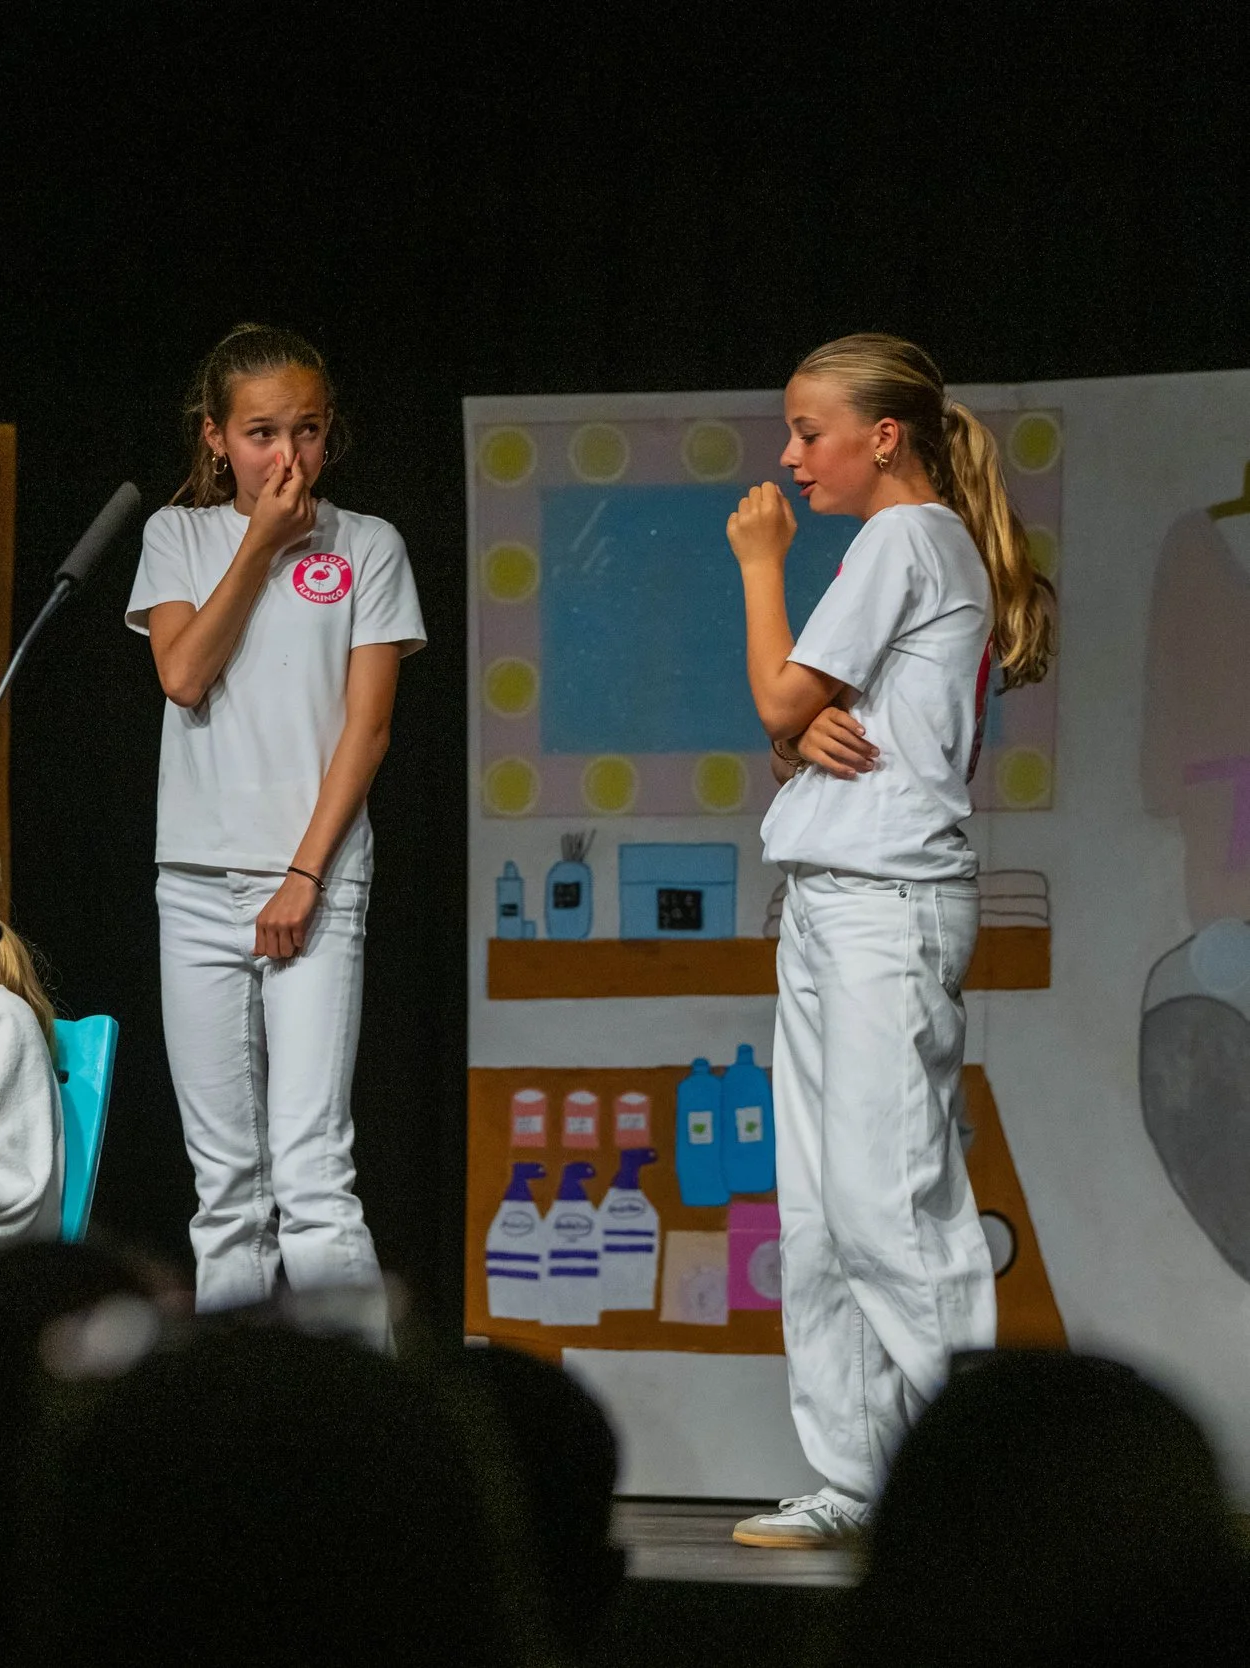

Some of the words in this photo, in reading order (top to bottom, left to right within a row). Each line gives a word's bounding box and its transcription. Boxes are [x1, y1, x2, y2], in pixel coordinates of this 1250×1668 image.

[301, 555, 317, 568] DE
[320, 555, 349, 571] ROZE
[297, 583, 344, 602] FLAMINGO
